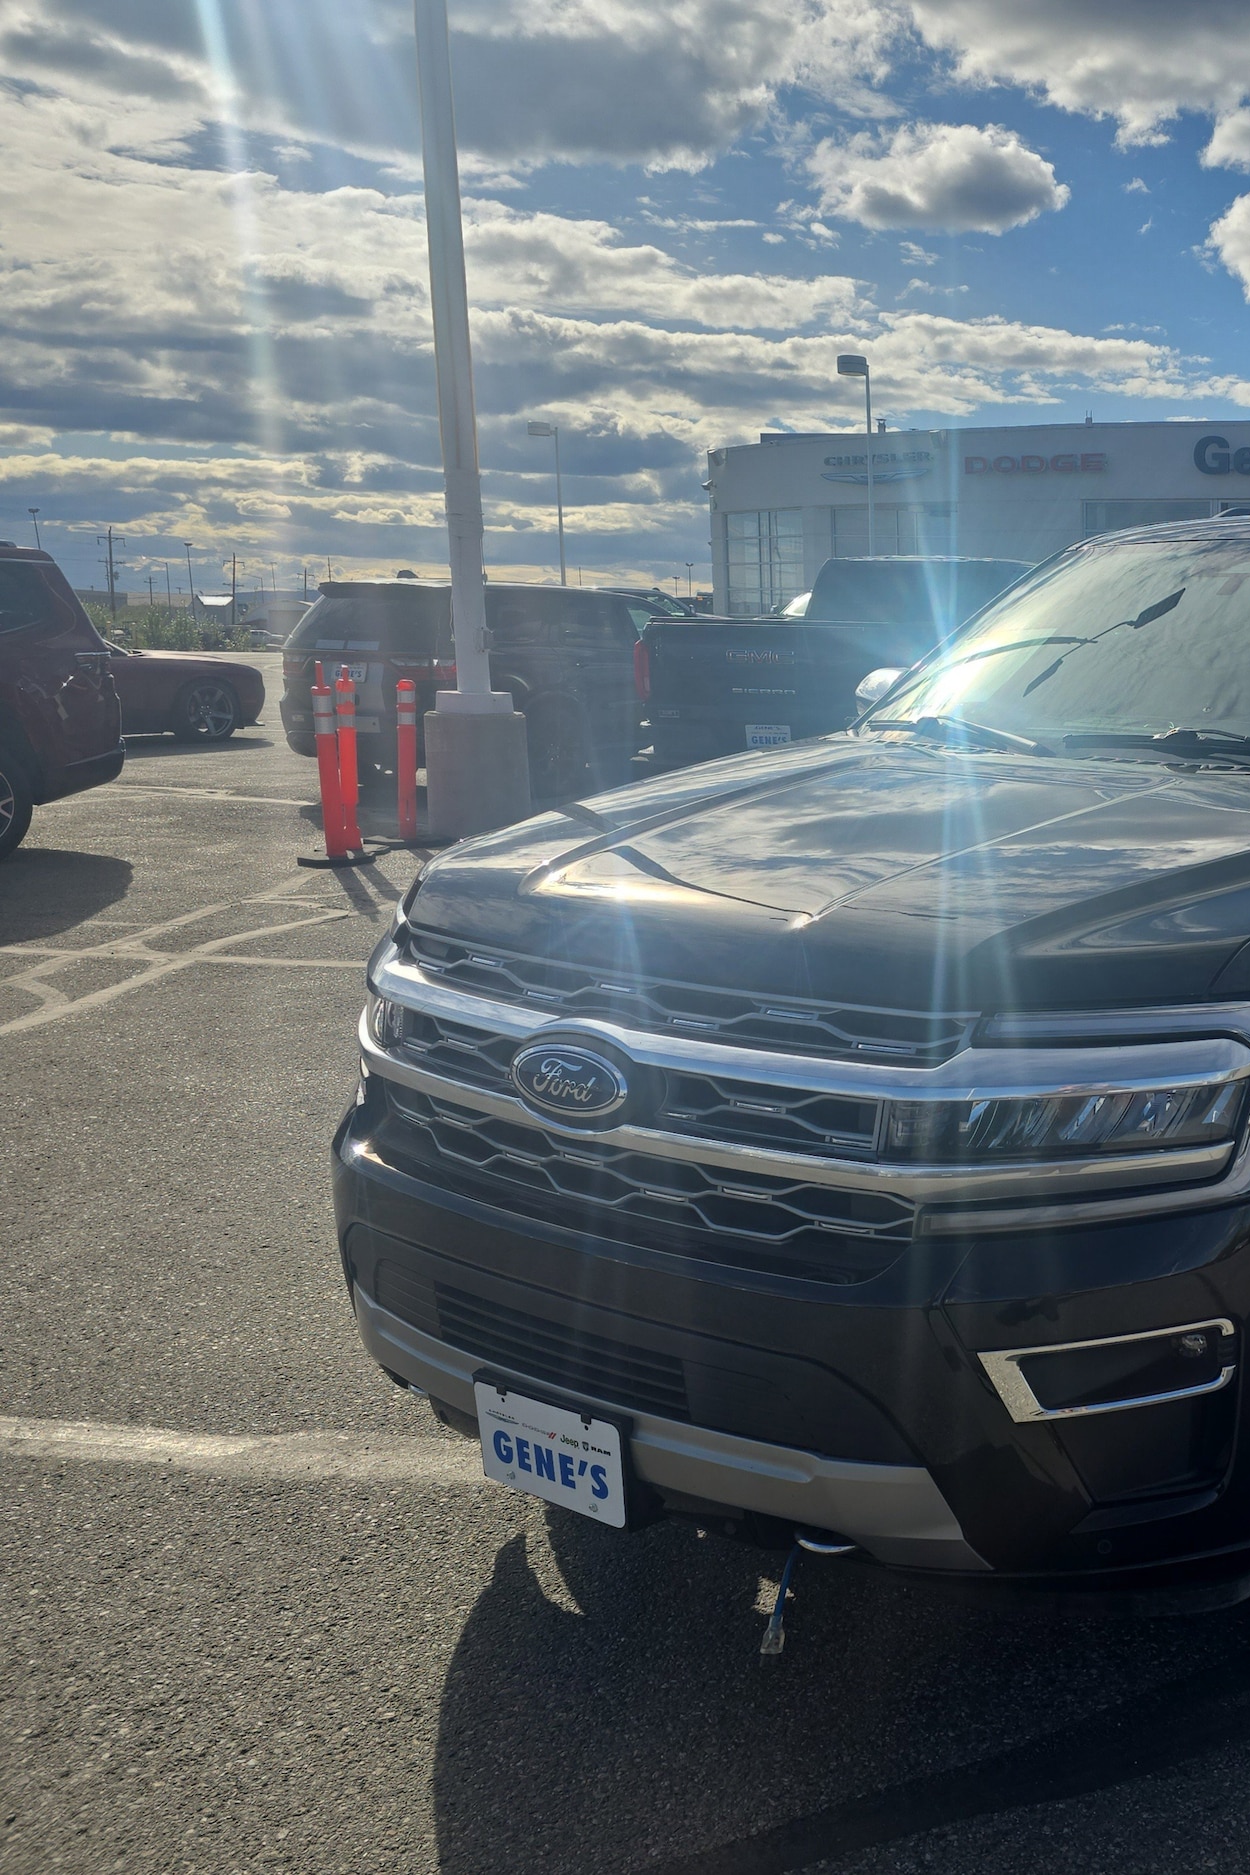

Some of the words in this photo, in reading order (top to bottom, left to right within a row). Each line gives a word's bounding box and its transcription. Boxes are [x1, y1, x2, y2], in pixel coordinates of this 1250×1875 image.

[964, 453, 1106, 475] DODGE
[726, 649, 795, 665] GMC
[335, 669, 362, 678] GE'S
[532, 1057, 597, 1102] Ford
[560, 1434, 580, 1449] Jeep
[493, 1430, 609, 1500] GENE'S
